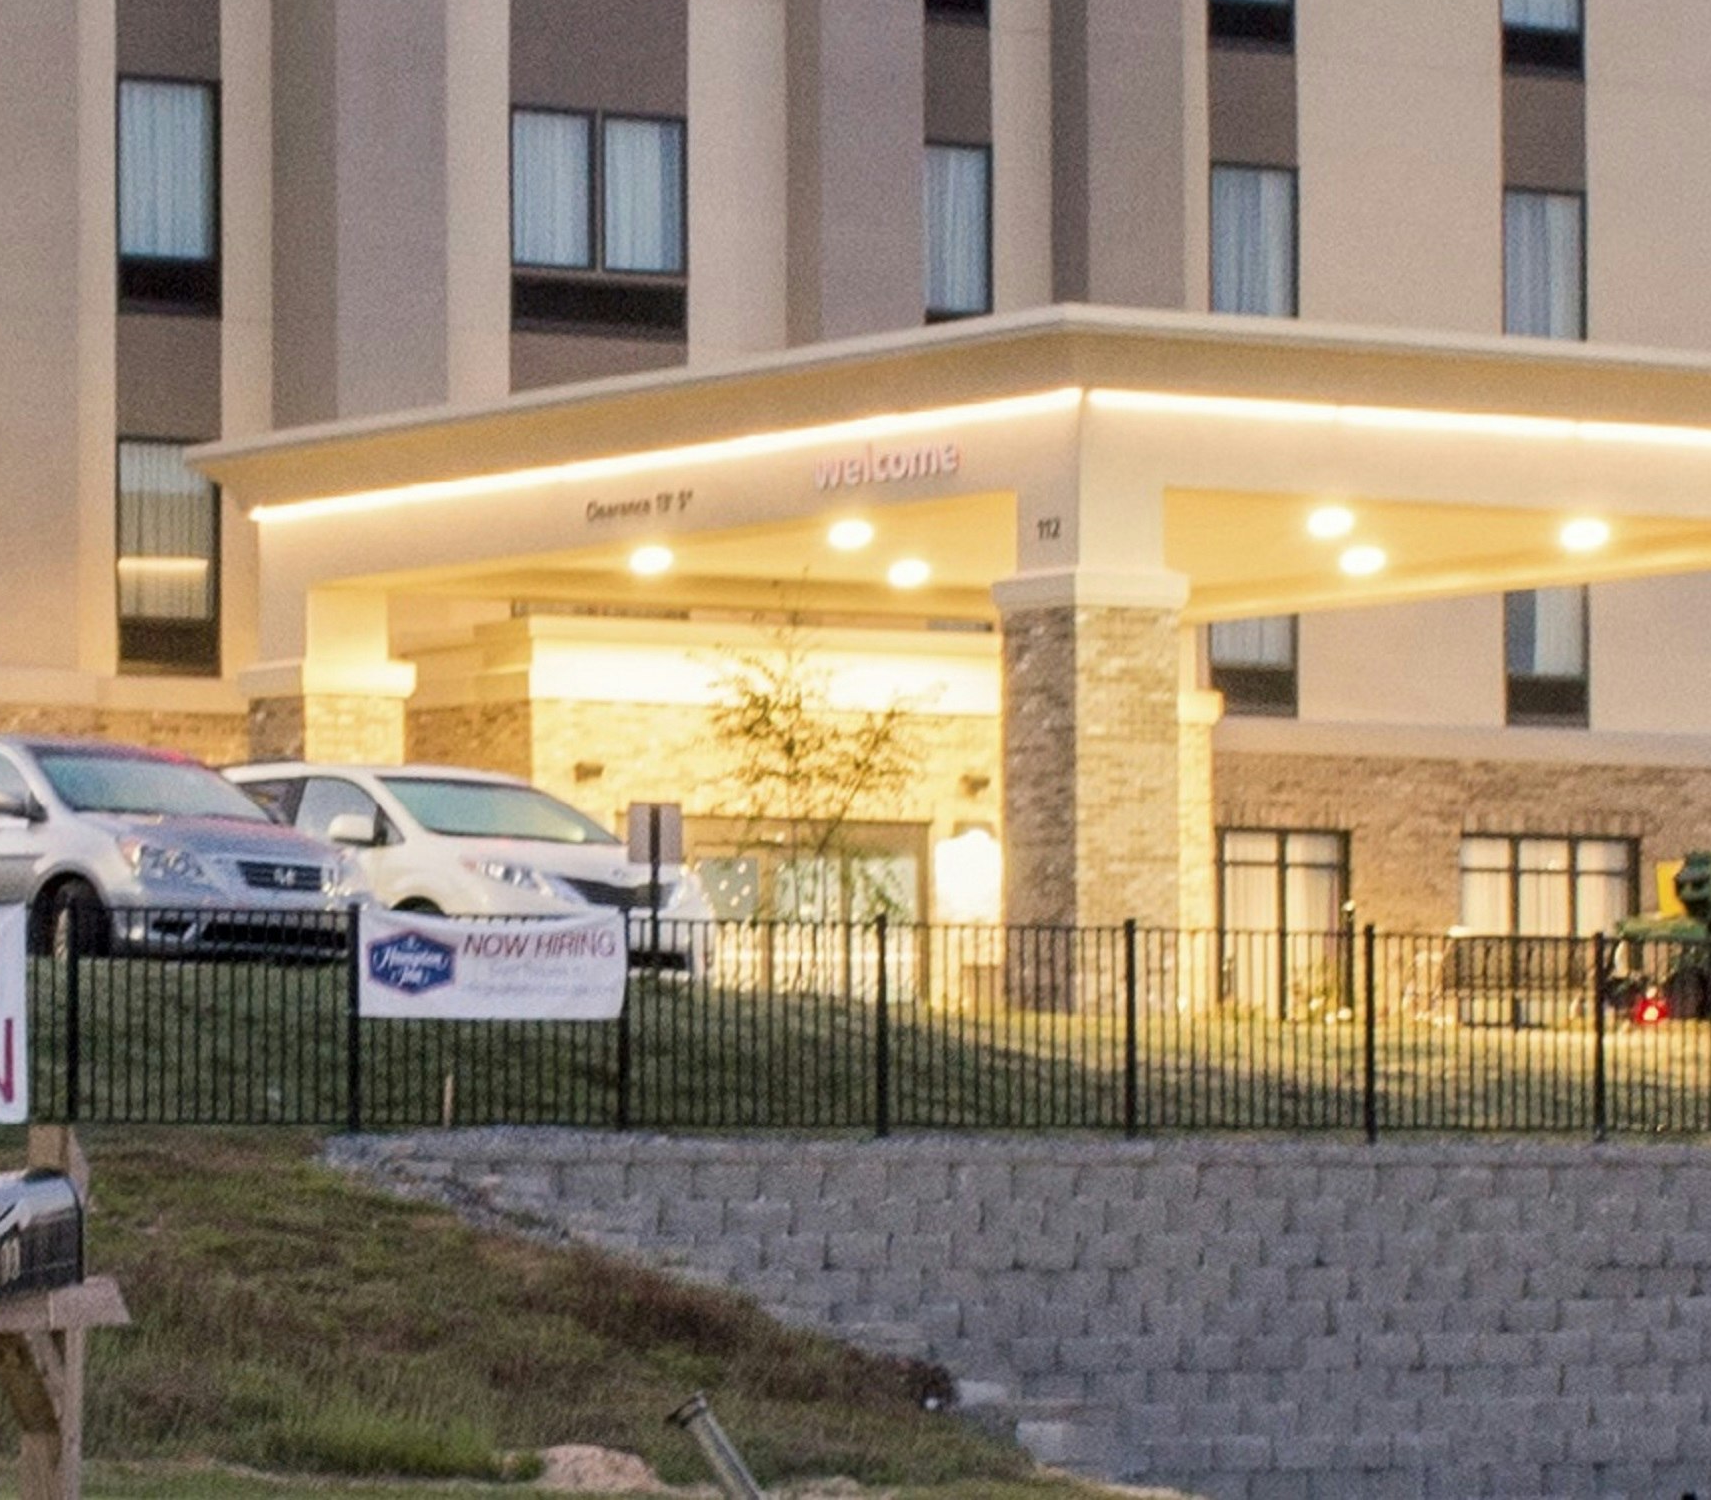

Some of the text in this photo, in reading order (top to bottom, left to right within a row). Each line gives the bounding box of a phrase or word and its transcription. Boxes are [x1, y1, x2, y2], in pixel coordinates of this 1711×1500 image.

[815, 443, 962, 488] welcome
[1037, 518, 1060, 540] 112
[464, 930, 616, 958] NOW HIRING
